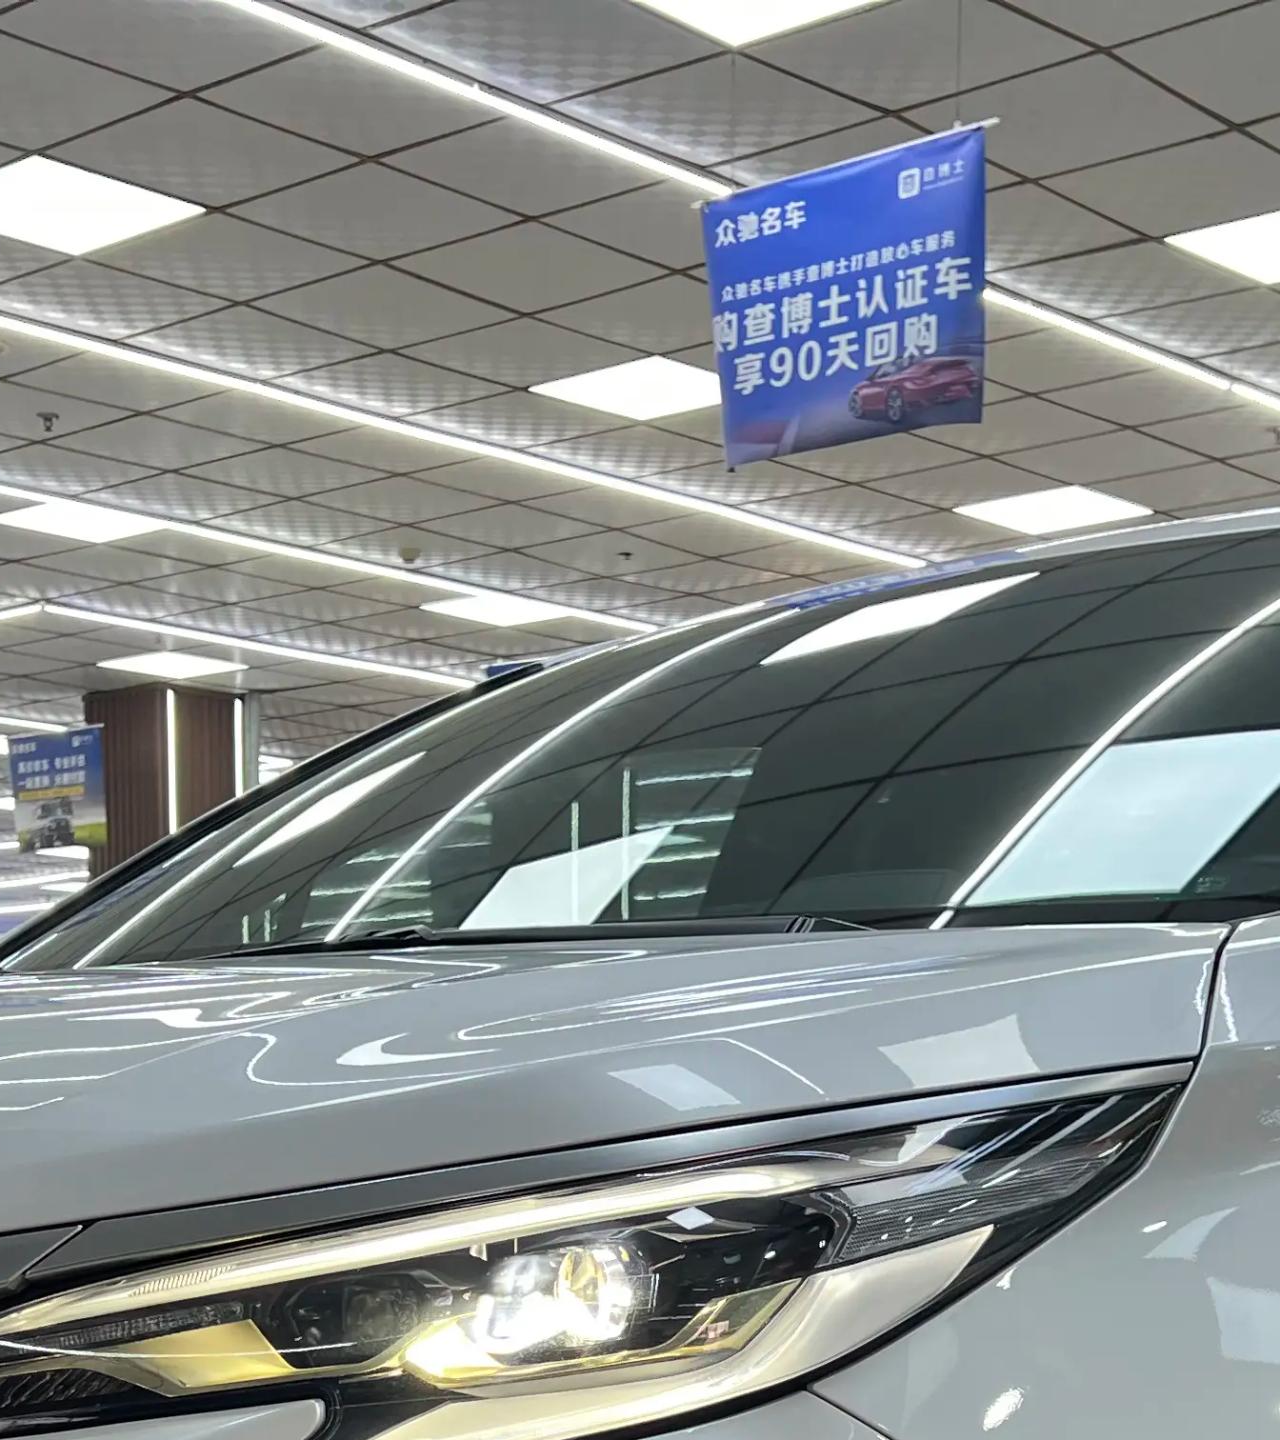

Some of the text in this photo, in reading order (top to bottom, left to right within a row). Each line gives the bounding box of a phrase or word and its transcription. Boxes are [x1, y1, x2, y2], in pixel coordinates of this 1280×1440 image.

[714, 200, 807, 249] 众驰名车
[733, 312, 939, 396] 享90天回购
